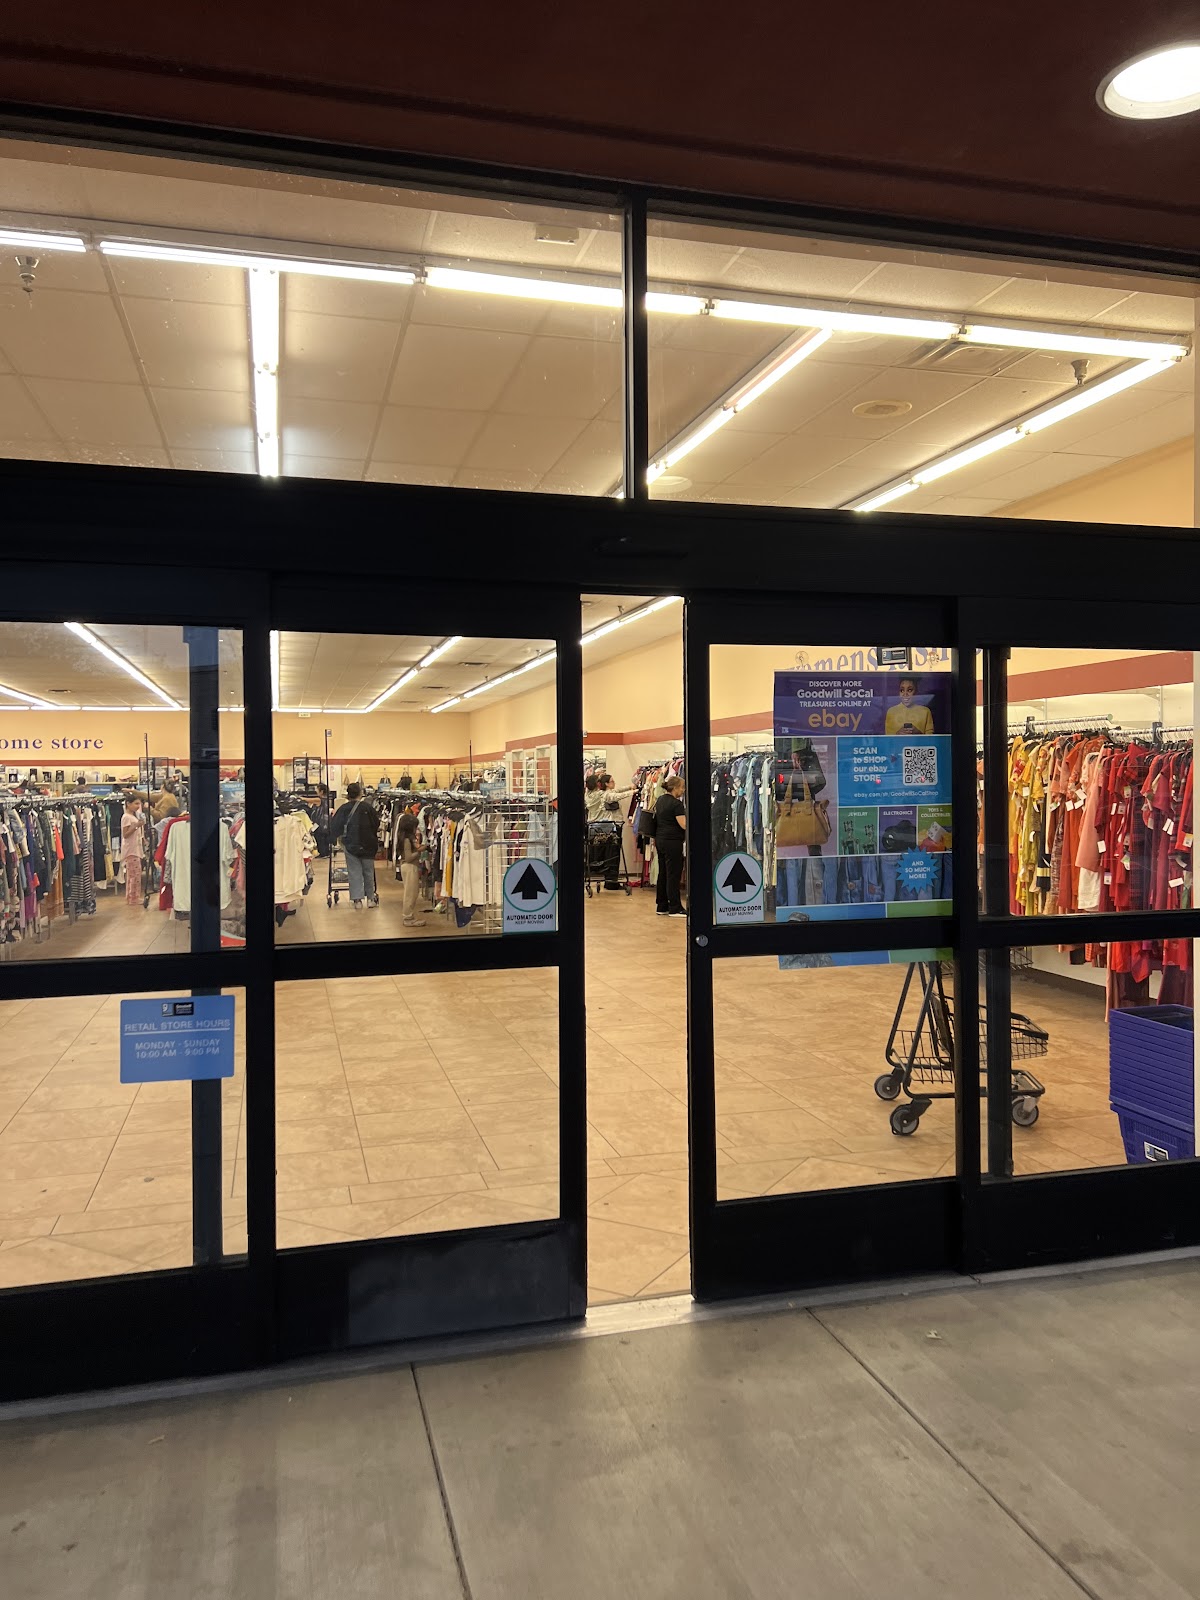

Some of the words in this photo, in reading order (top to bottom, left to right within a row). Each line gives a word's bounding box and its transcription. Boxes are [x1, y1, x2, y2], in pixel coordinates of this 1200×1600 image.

[796, 688, 842, 698] Goodwill
[844, 688, 874, 698] SoCal
[808, 708, 862, 732] ebay
[51, 736, 104, 749] store
[868, 765, 888, 773] ebay
[124, 1023, 158, 1032] RETAIL
[161, 1020, 192, 1030] STORE
[196, 1019, 230, 1028] HOURS
[135, 1041, 176, 1050] MONDAY
[184, 1039, 220, 1048] SUNDAY
[184, 1048, 203, 1056] 9:00
